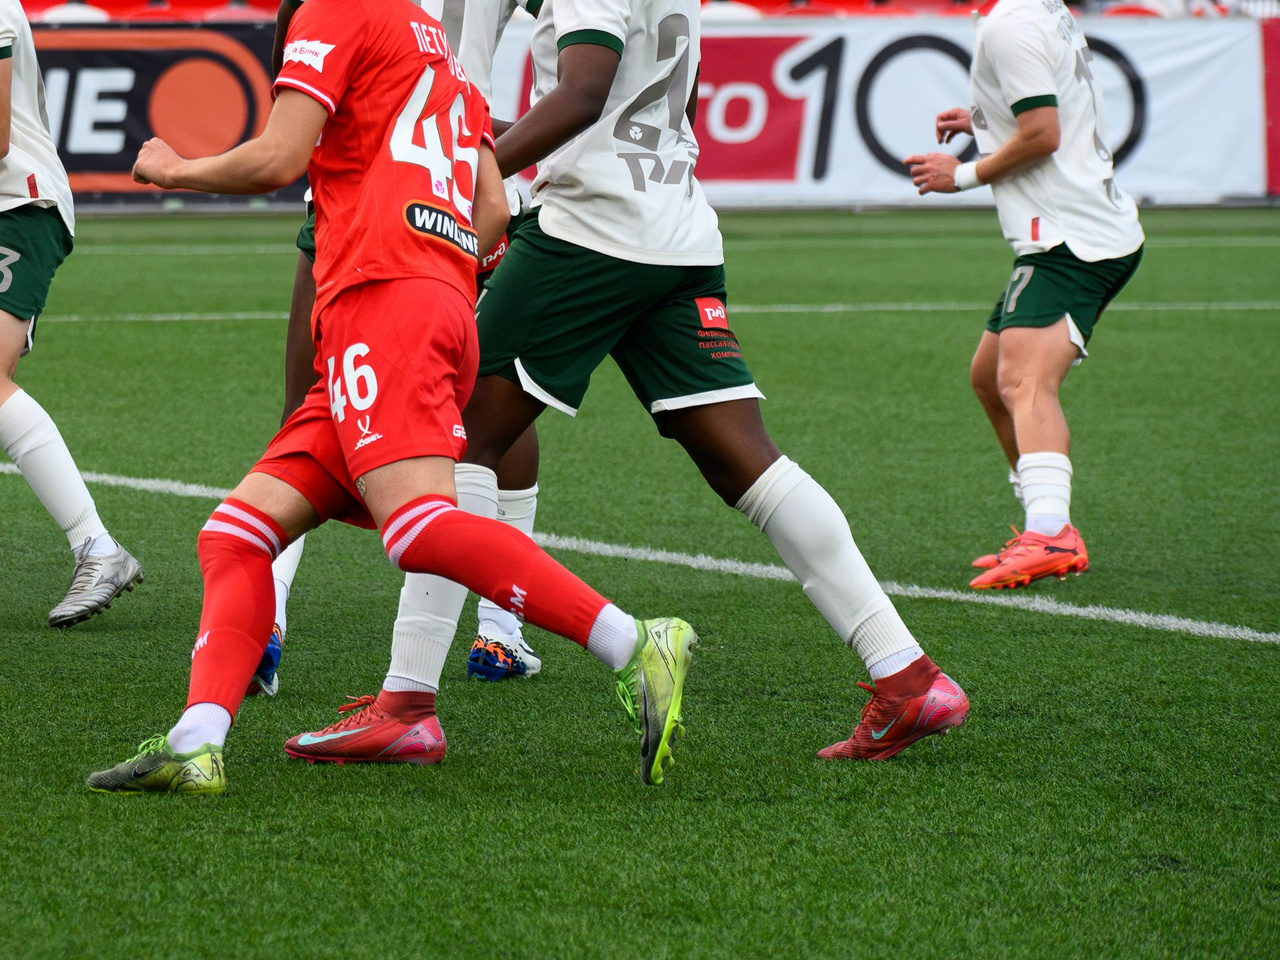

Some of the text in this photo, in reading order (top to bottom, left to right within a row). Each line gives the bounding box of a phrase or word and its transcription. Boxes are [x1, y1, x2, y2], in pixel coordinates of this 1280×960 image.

[389, 63, 480, 229] 46
[1008, 265, 1036, 314] 7
[326, 342, 378, 424] 46
